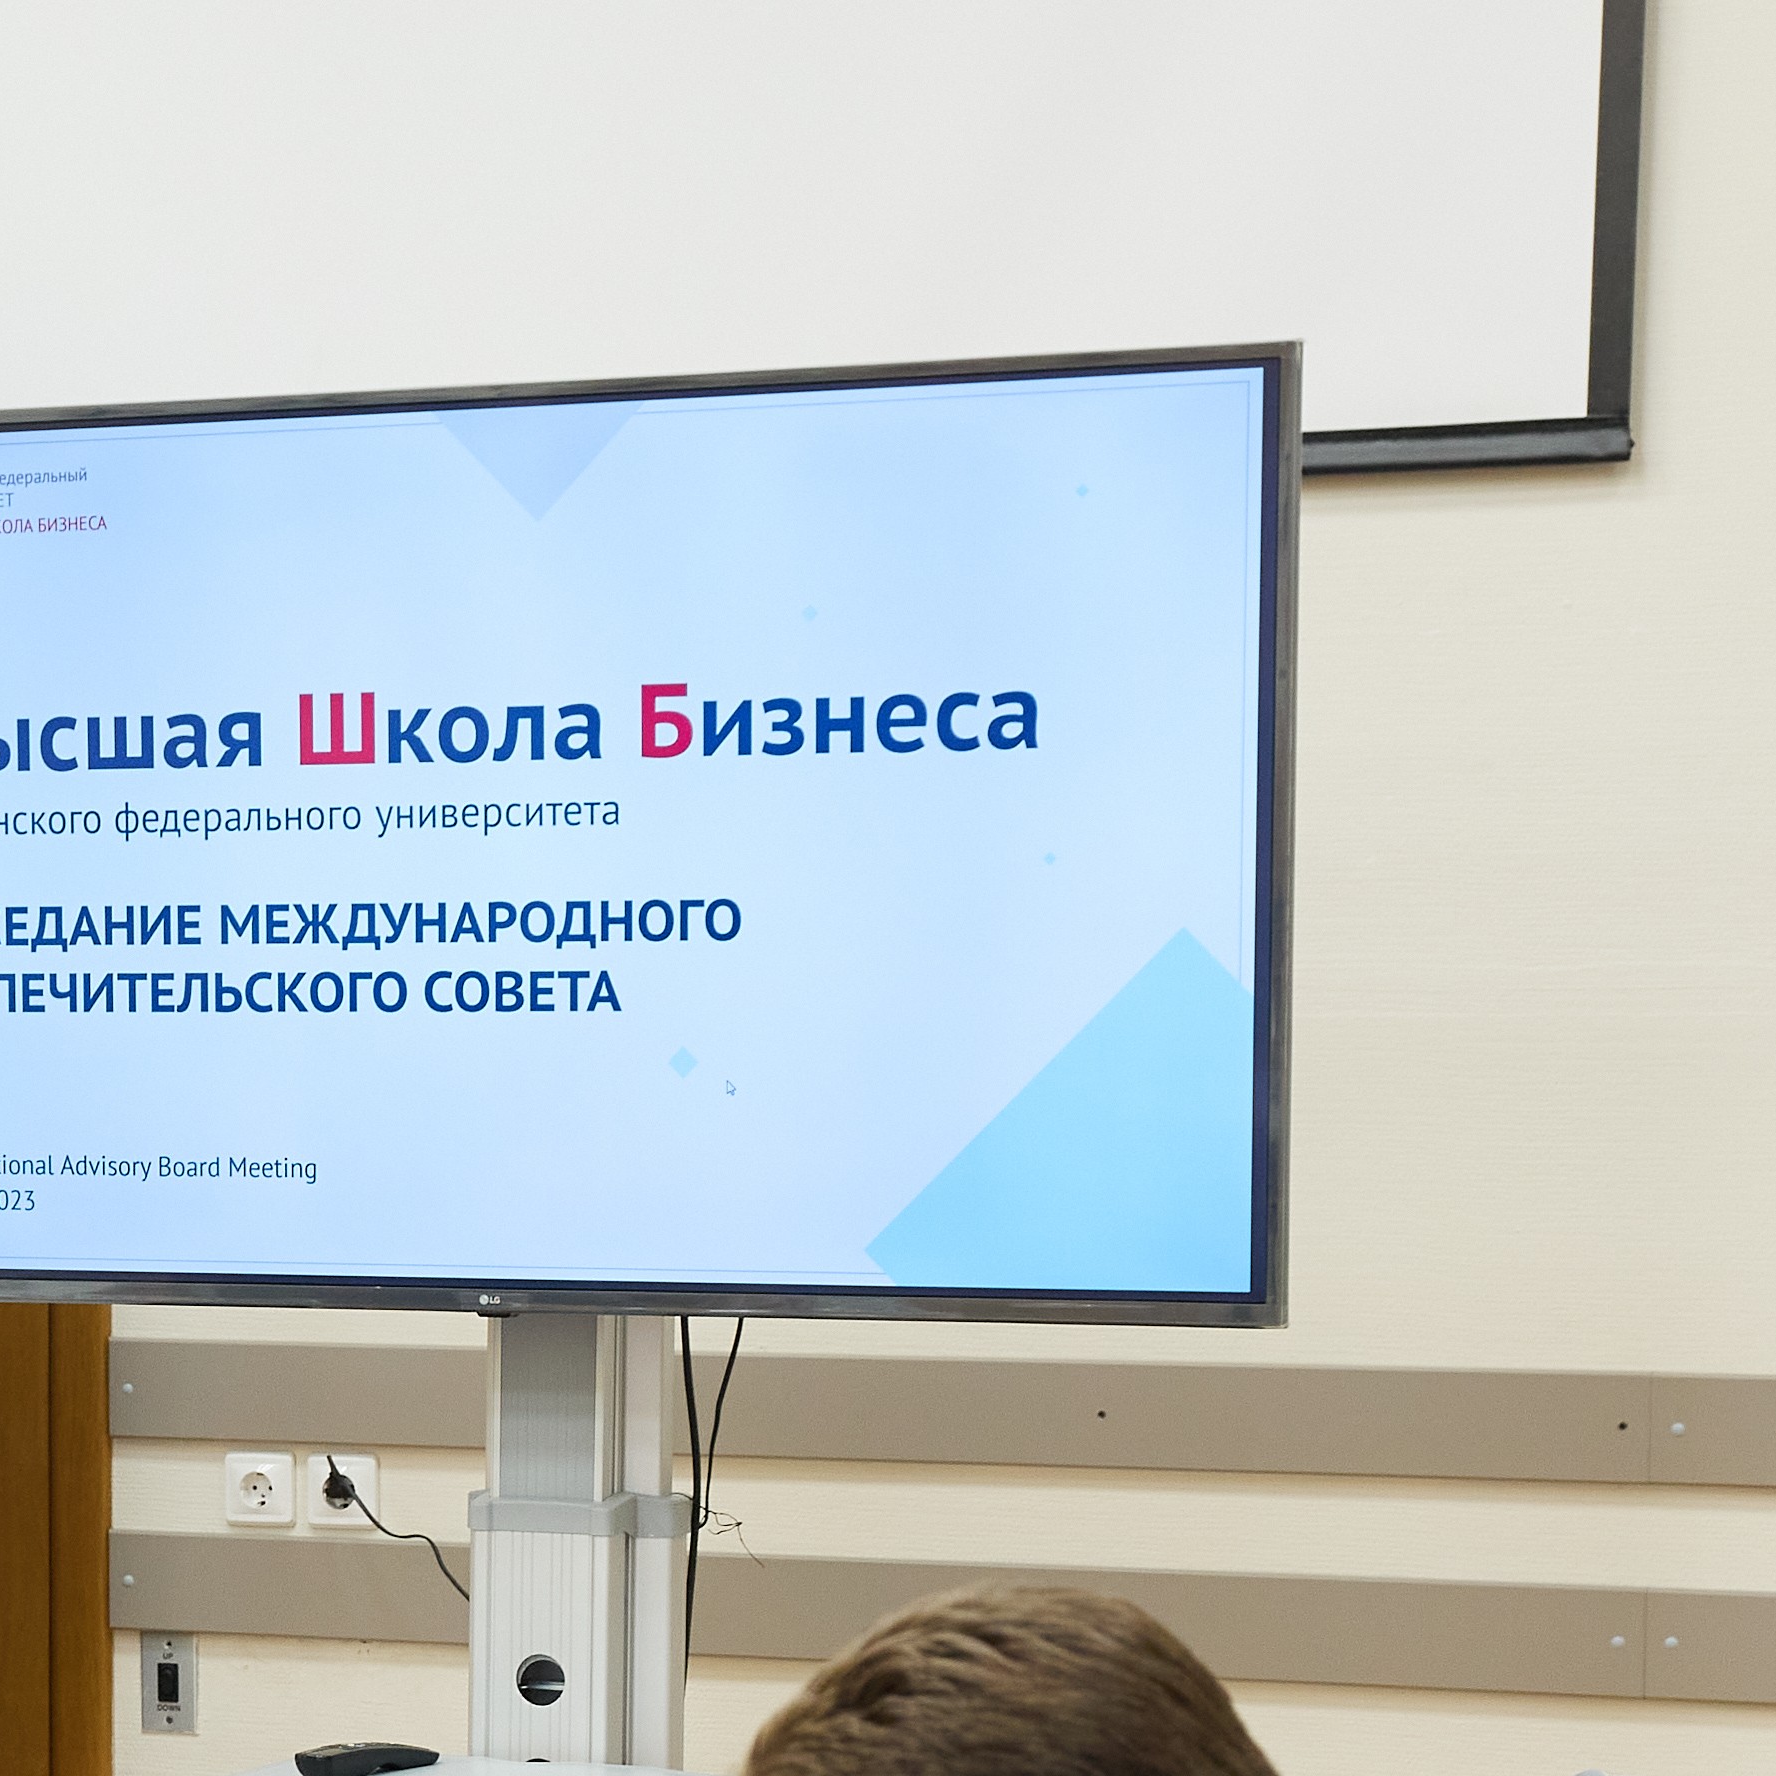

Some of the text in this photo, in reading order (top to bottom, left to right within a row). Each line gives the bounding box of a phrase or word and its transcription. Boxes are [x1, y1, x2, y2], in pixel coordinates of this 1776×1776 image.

[38, 516, 108, 533] БИЗНЕСА
[297, 691, 604, 767] Школа
[639, 681, 1041, 760] Бизнеса
[114, 794, 362, 843] федерального
[375, 793, 620, 836] университета
[221, 897, 742, 951] МЕЖДУНАРОДНОГО
[426, 967, 620, 1014] СОВЕТА
[61, 1155, 152, 1181] Advisory
[158, 1156, 220, 1178] Board
[228, 1157, 318, 1184] Meeting
[489, 1296, 501, 1304] LG
